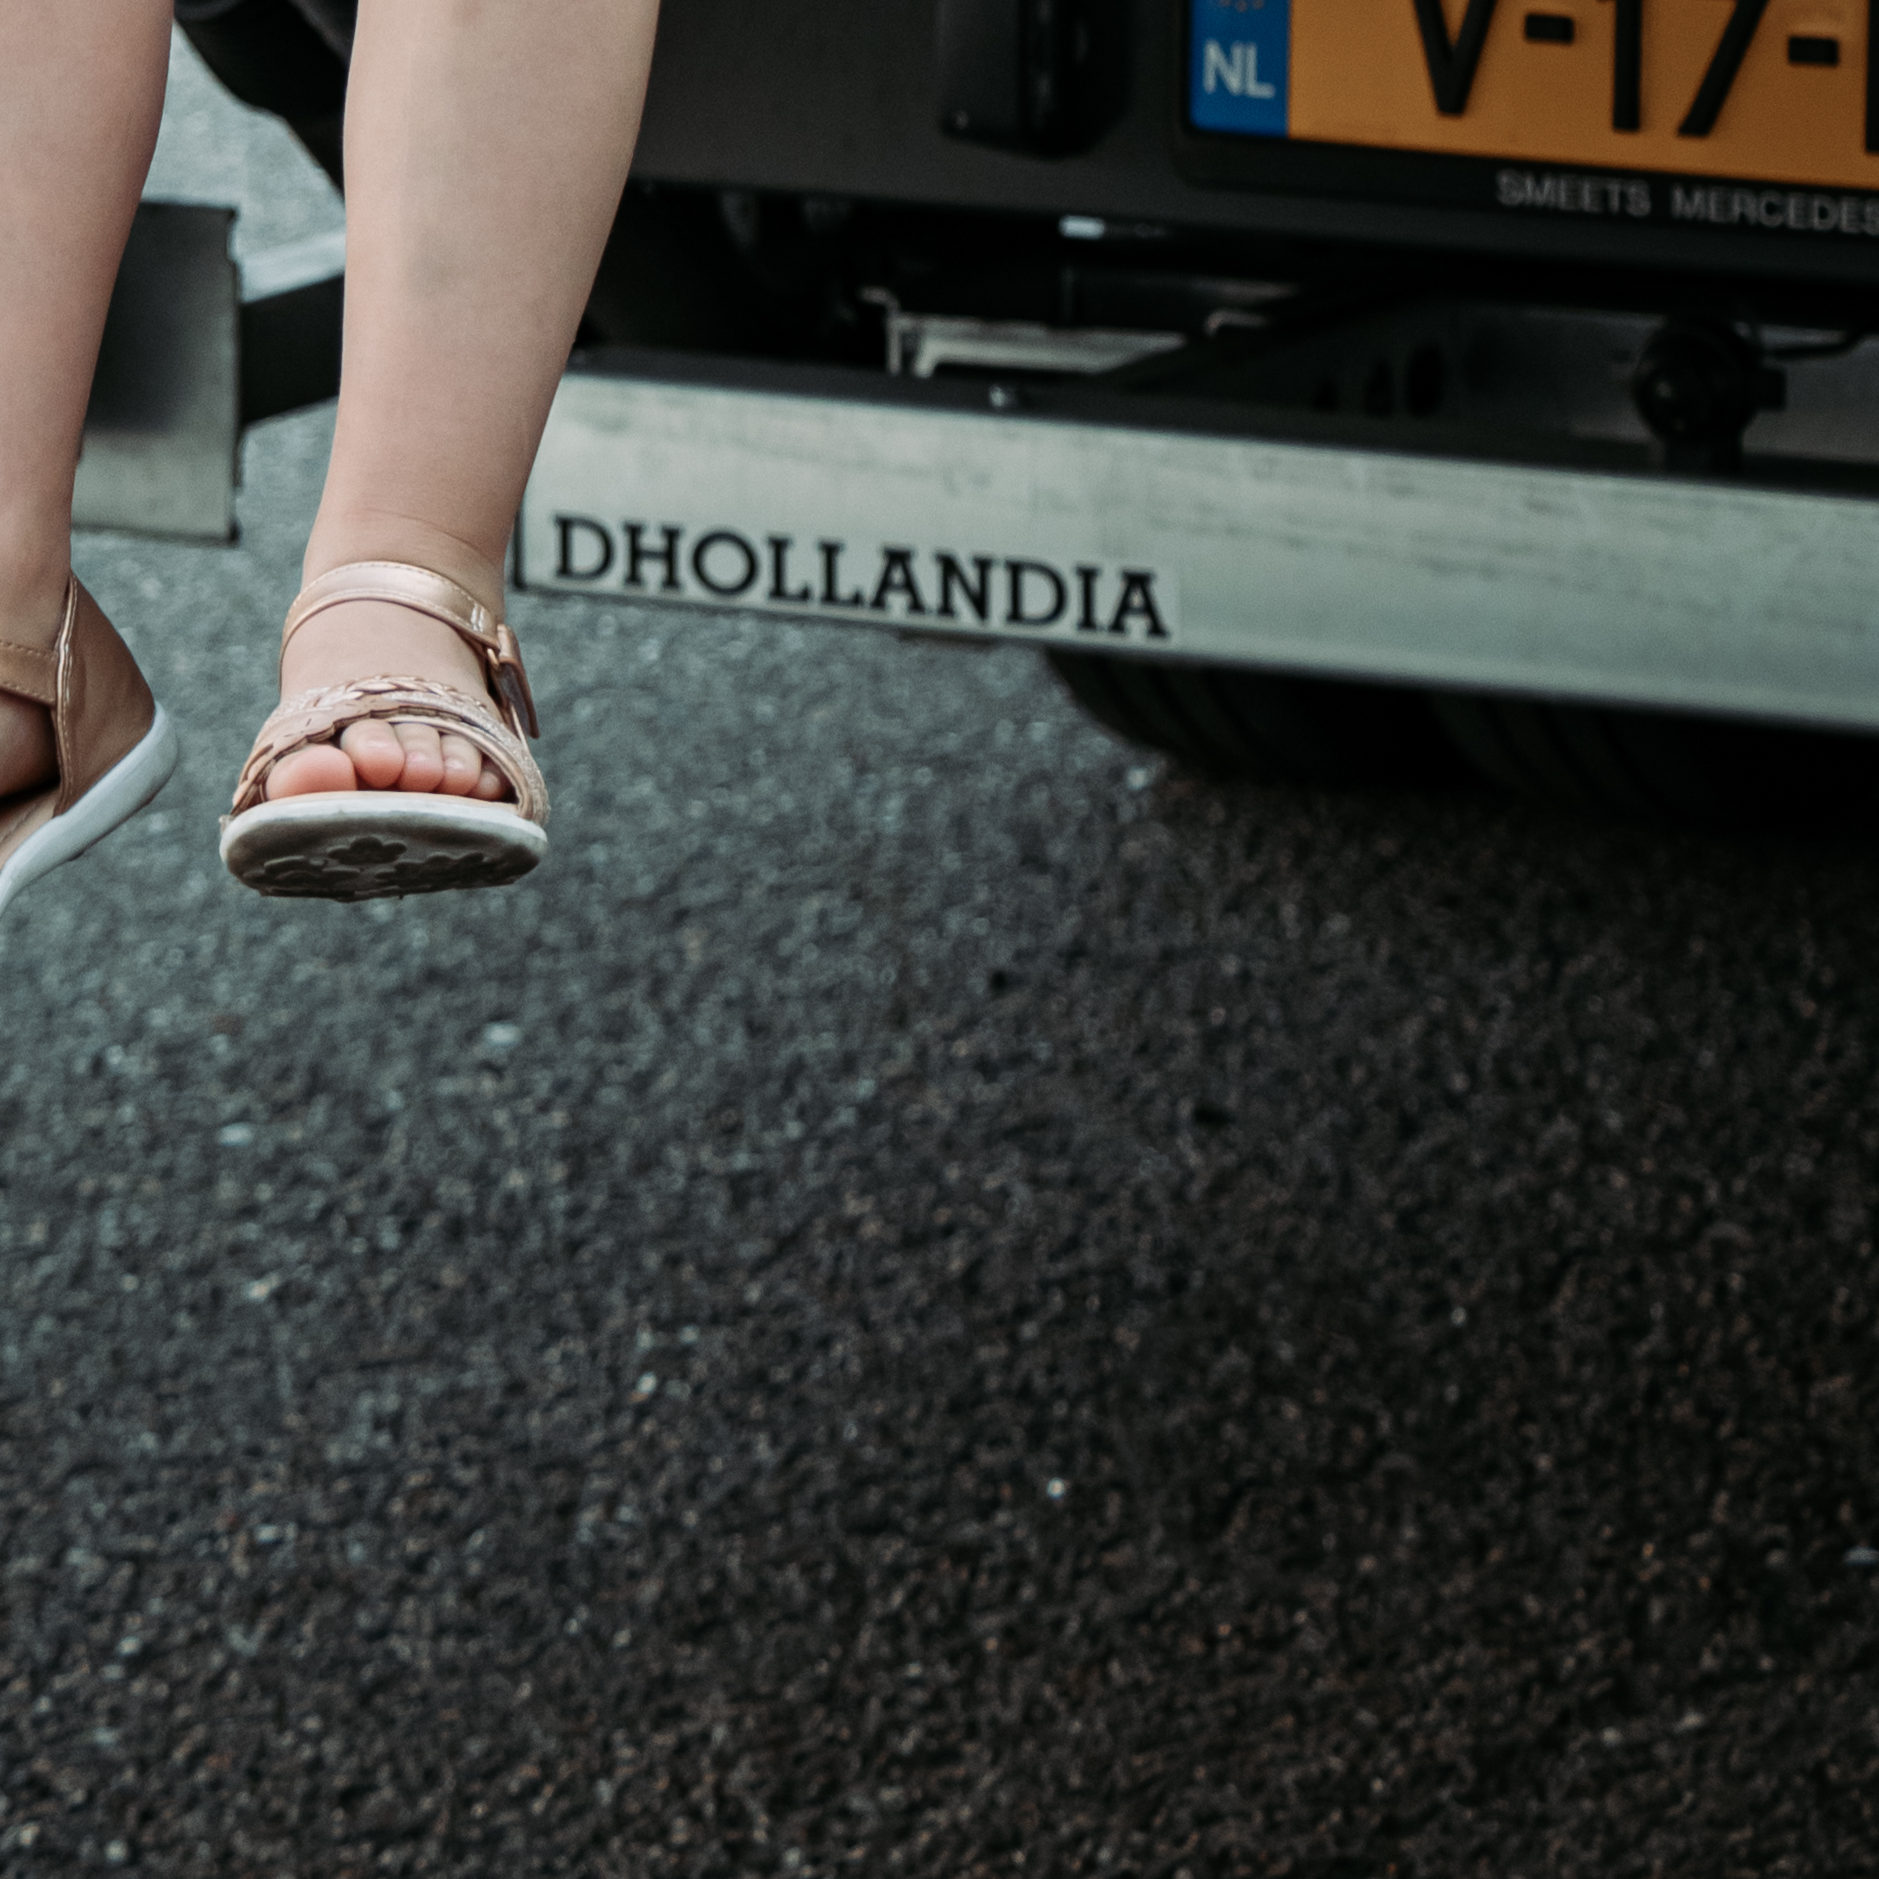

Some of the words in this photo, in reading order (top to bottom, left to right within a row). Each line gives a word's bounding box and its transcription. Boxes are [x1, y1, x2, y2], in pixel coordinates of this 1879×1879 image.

[1203, 39, 1276, 99] NL
[1495, 168, 1652, 217] SMEETS
[552, 513, 1171, 640] DHOLLANDIA
